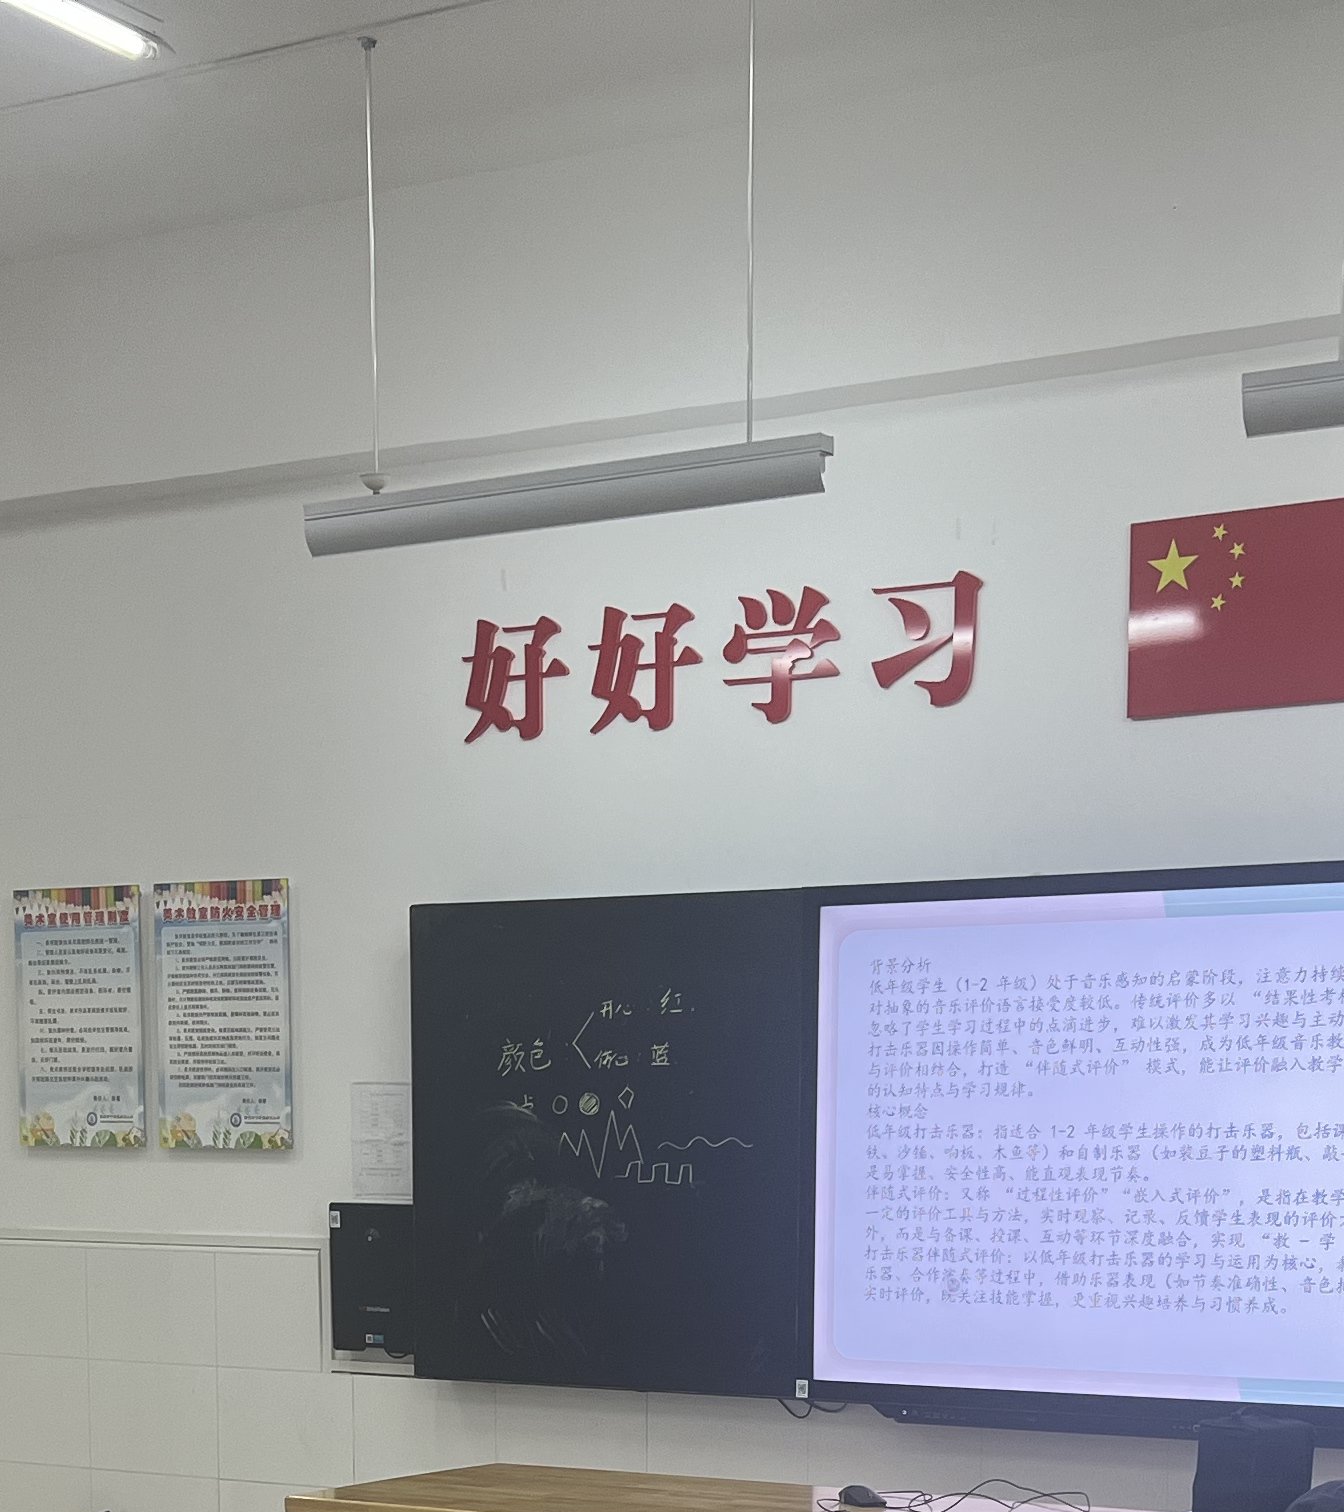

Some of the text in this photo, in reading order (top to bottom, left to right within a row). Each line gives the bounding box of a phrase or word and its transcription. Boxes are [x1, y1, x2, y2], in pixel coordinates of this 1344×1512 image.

[459, 568, 984, 748] 好好学习
[869, 957, 932, 974] 背景分析
[867, 1081, 1034, 1099] 的认知特点与学习规律。
[865, 1102, 928, 1120] 核心概念
